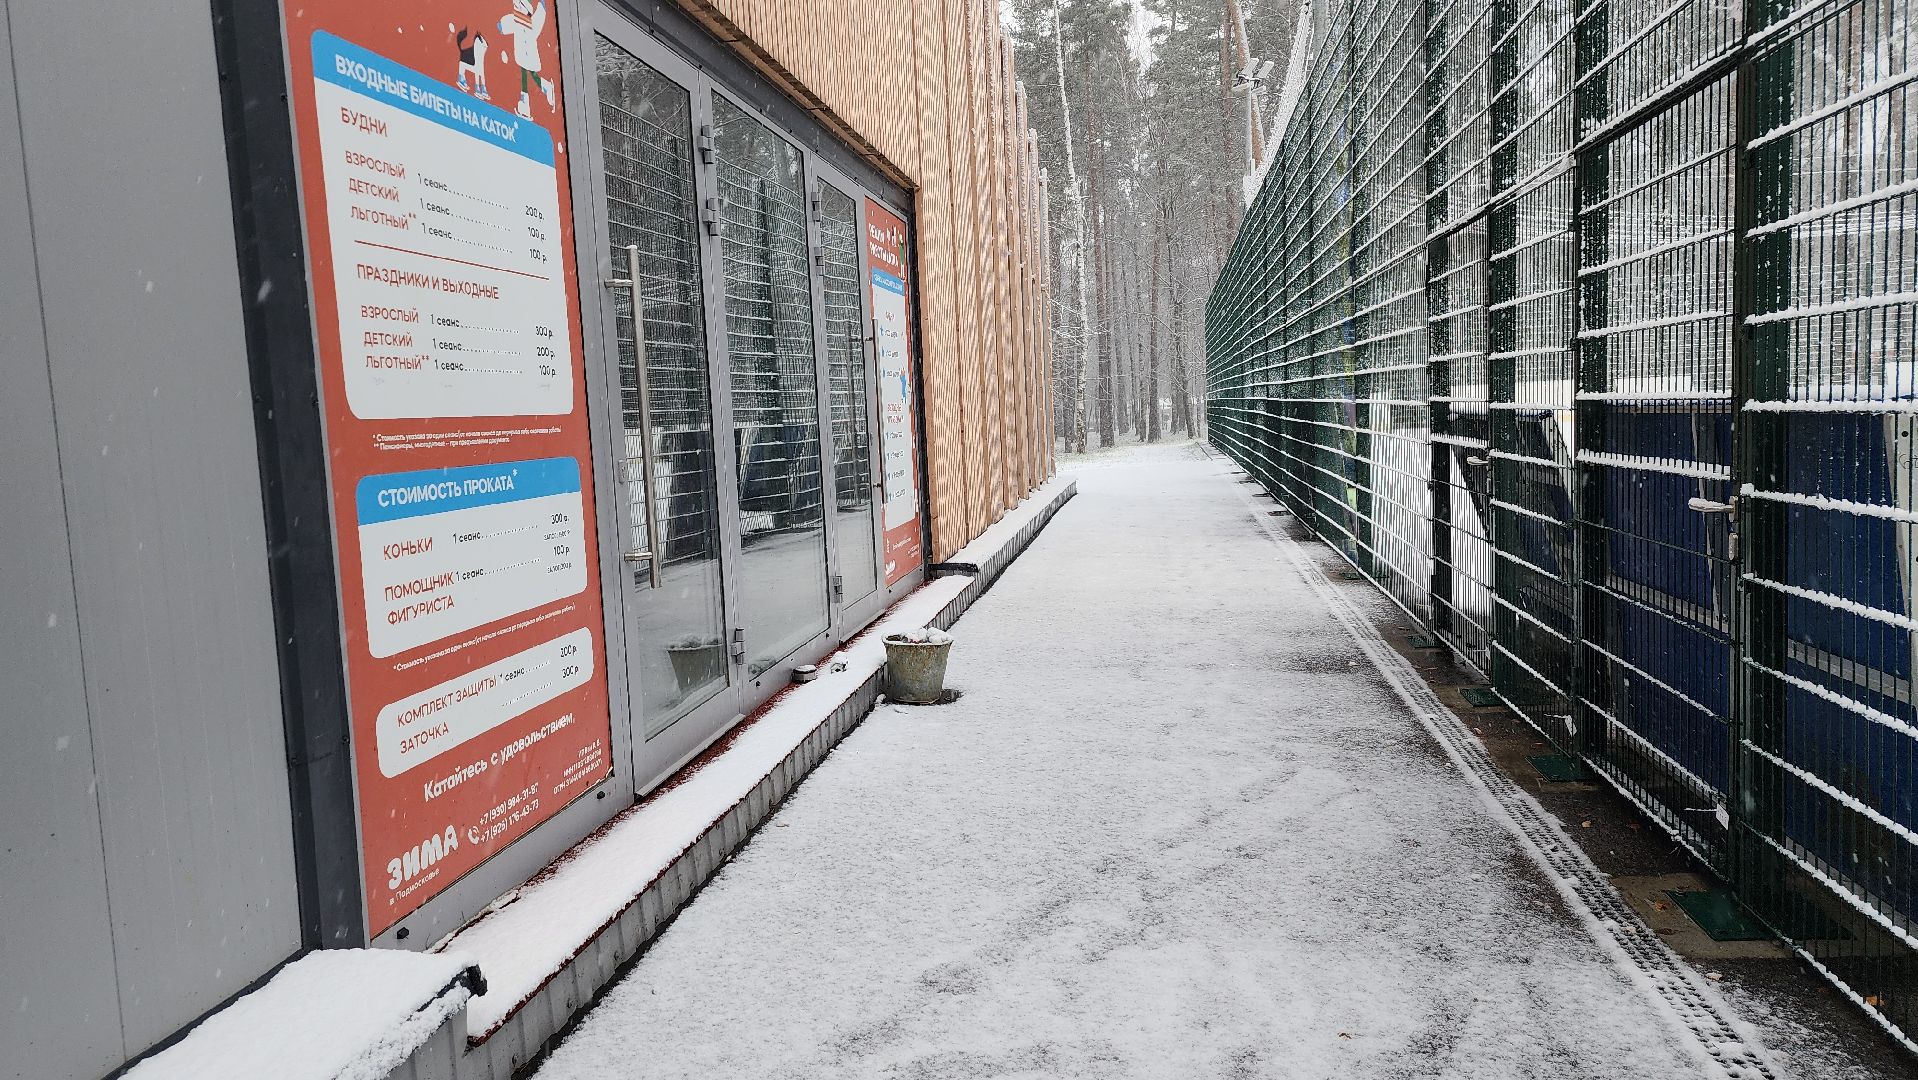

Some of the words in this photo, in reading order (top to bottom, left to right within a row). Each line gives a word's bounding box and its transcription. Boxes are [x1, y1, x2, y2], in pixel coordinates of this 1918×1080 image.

[335, 53, 409, 100] ВХОДНЫЕ
[410, 84, 462, 121] БИЛЕТЫ
[463, 106, 480, 128] НА
[341, 106, 388, 137] БУДНИ
[345, 150, 406, 180] ВЗРОСЛЫЙ
[525, 205, 538, 218] 200
[348, 178, 400, 202] ДЕТСКИЙ
[528, 226, 540, 238] 100
[529, 248, 540, 260] 100
[356, 264, 430, 288] ПРАЗДНИКИ
[432, 276, 440, 290] И
[442, 278, 499, 299] ВЫХОДНЫЕ
[361, 304, 418, 323] ВЗРОСЛЫЙ
[535, 326, 547, 336] 300
[364, 332, 413, 348] ДЕТСКИЙ
[537, 347, 549, 357] 200
[539, 365, 551, 376] 100
[378, 481, 462, 507] СТОИМОСТЬ
[384, 536, 433, 560] КОНЬКИ
[551, 513, 562, 524] 300
[384, 572, 454, 601] ПОМОЩНИК
[554, 545, 564, 556] 100
[388, 594, 454, 625] ФИГУРИСТА
[397, 692, 453, 727] КОМПЛЕКТ
[456, 676, 497, 703] ЗАЩИТЫ
[400, 722, 449, 754] ЗАТОЧКА
[423, 760, 488, 802] Катайтесь
[490, 752, 498, 765] с
[480, 812, 489, 826] +7
[480, 830, 490, 843] +7
[387, 825, 458, 890] ЗИМА
[390, 897, 394, 905] в
[396, 868, 440, 900] Подмосковье
